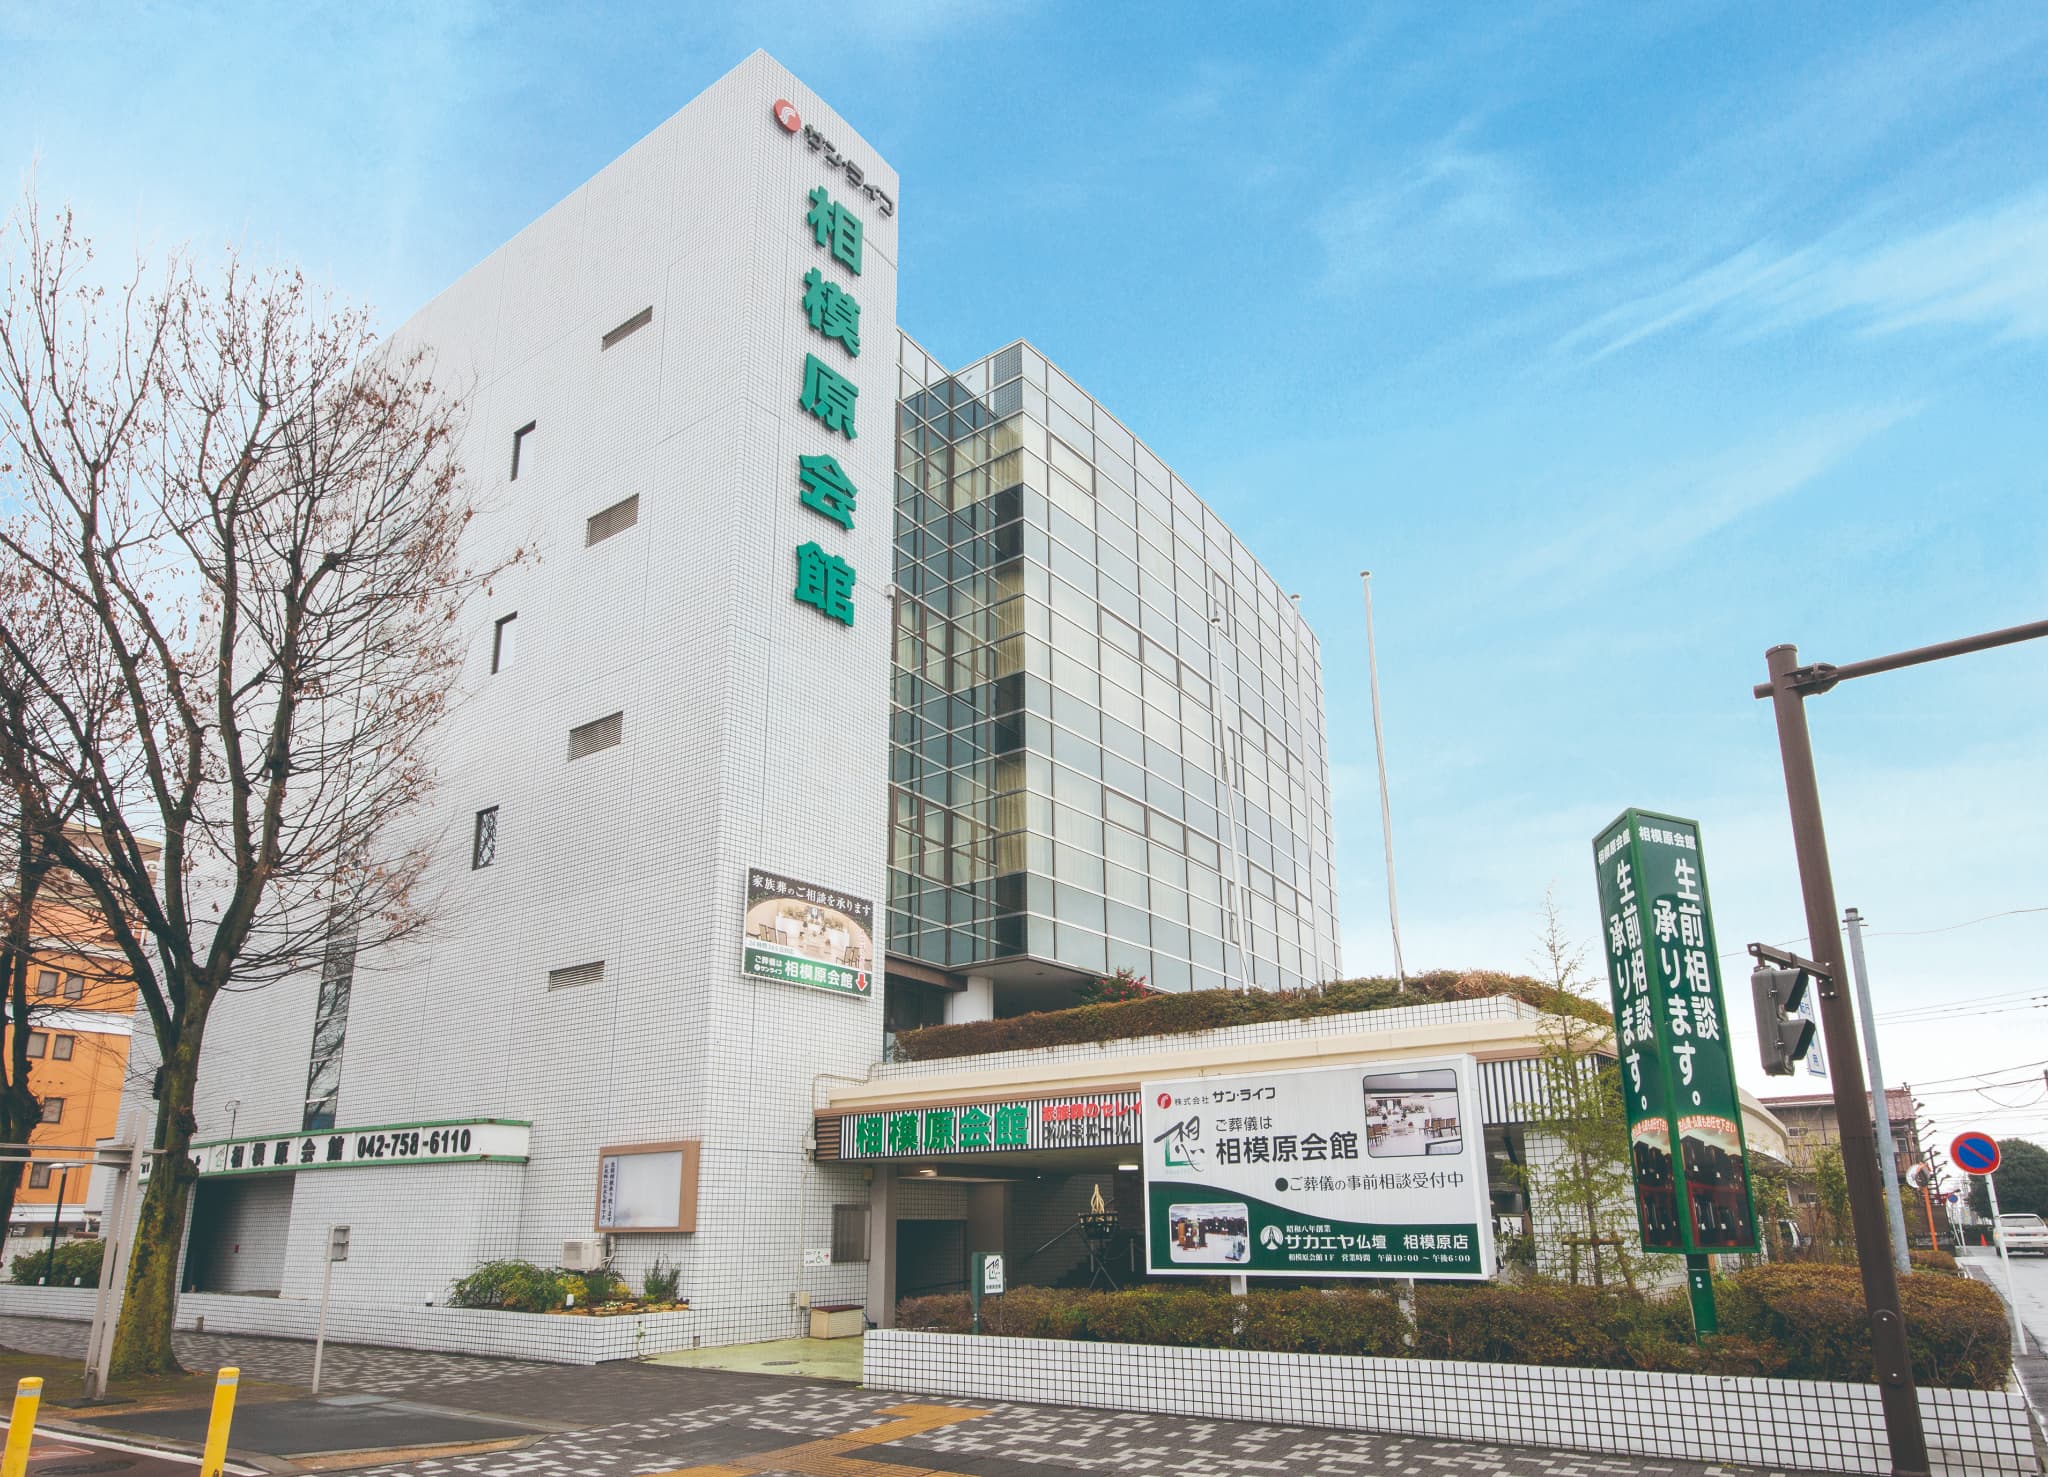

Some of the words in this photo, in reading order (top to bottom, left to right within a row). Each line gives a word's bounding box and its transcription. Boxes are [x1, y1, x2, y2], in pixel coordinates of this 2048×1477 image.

[794, 185, 863, 628] 相模原会館
[1638, 826, 1697, 851] 相模原会館
[752, 874, 871, 917] 家族葬のご相談を承ります
[1616, 859, 1653, 1042] 生前相談
[1674, 858, 1719, 1041] 生前相談
[785, 960, 853, 989] 相模原会館
[1609, 913, 1648, 1110] 承ります。
[1653, 900, 1701, 1106] 承ります。
[1174, 1096, 1210, 1106] 株式会社
[855, 1104, 1030, 1153] 相模原会館
[1215, 1116, 1273, 1132] ご葬儀は
[357, 1128, 472, 1159] 042-758-6110
[1215, 1131, 1359, 1165] 相模原会館
[1289, 1171, 1465, 1192] ご葬儀の事前相談受付中
[1285, 1233, 1387, 1250] サカエヤ仏壇
[1403, 1233, 1469, 1250] 相模原店
[1341, 1253, 1371, 1262] 営業時間
